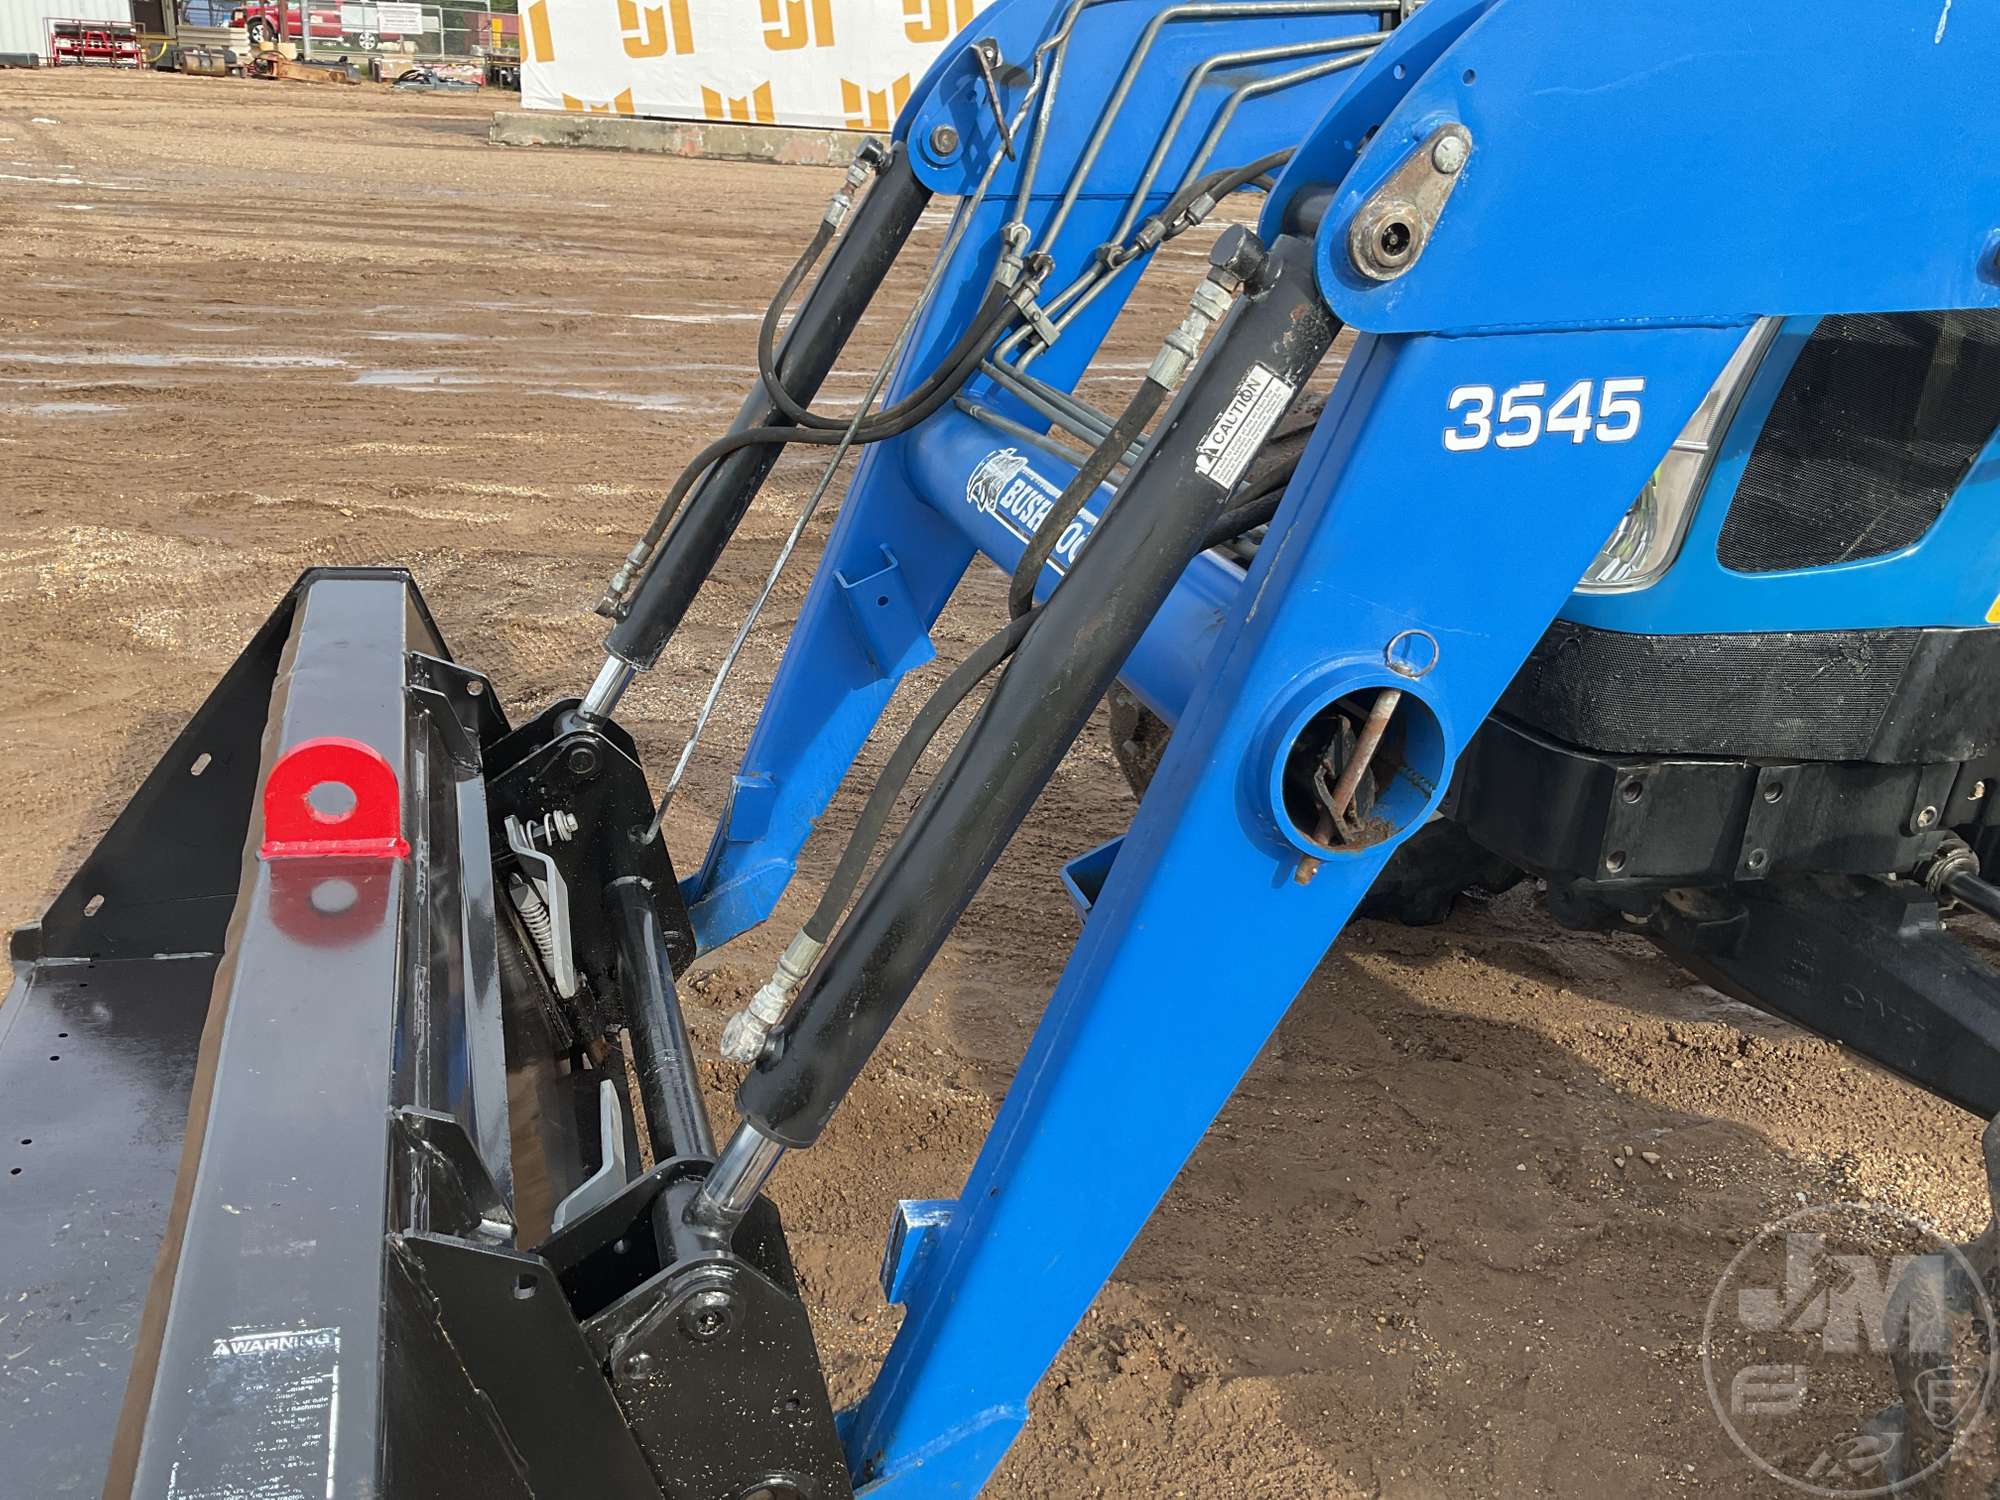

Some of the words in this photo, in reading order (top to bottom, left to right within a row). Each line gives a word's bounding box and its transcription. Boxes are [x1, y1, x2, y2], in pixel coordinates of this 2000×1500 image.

[1212, 377, 1262, 445] CAUTION
[1443, 376, 1646, 452] 3545
[230, 1333, 331, 1355] WARNING
